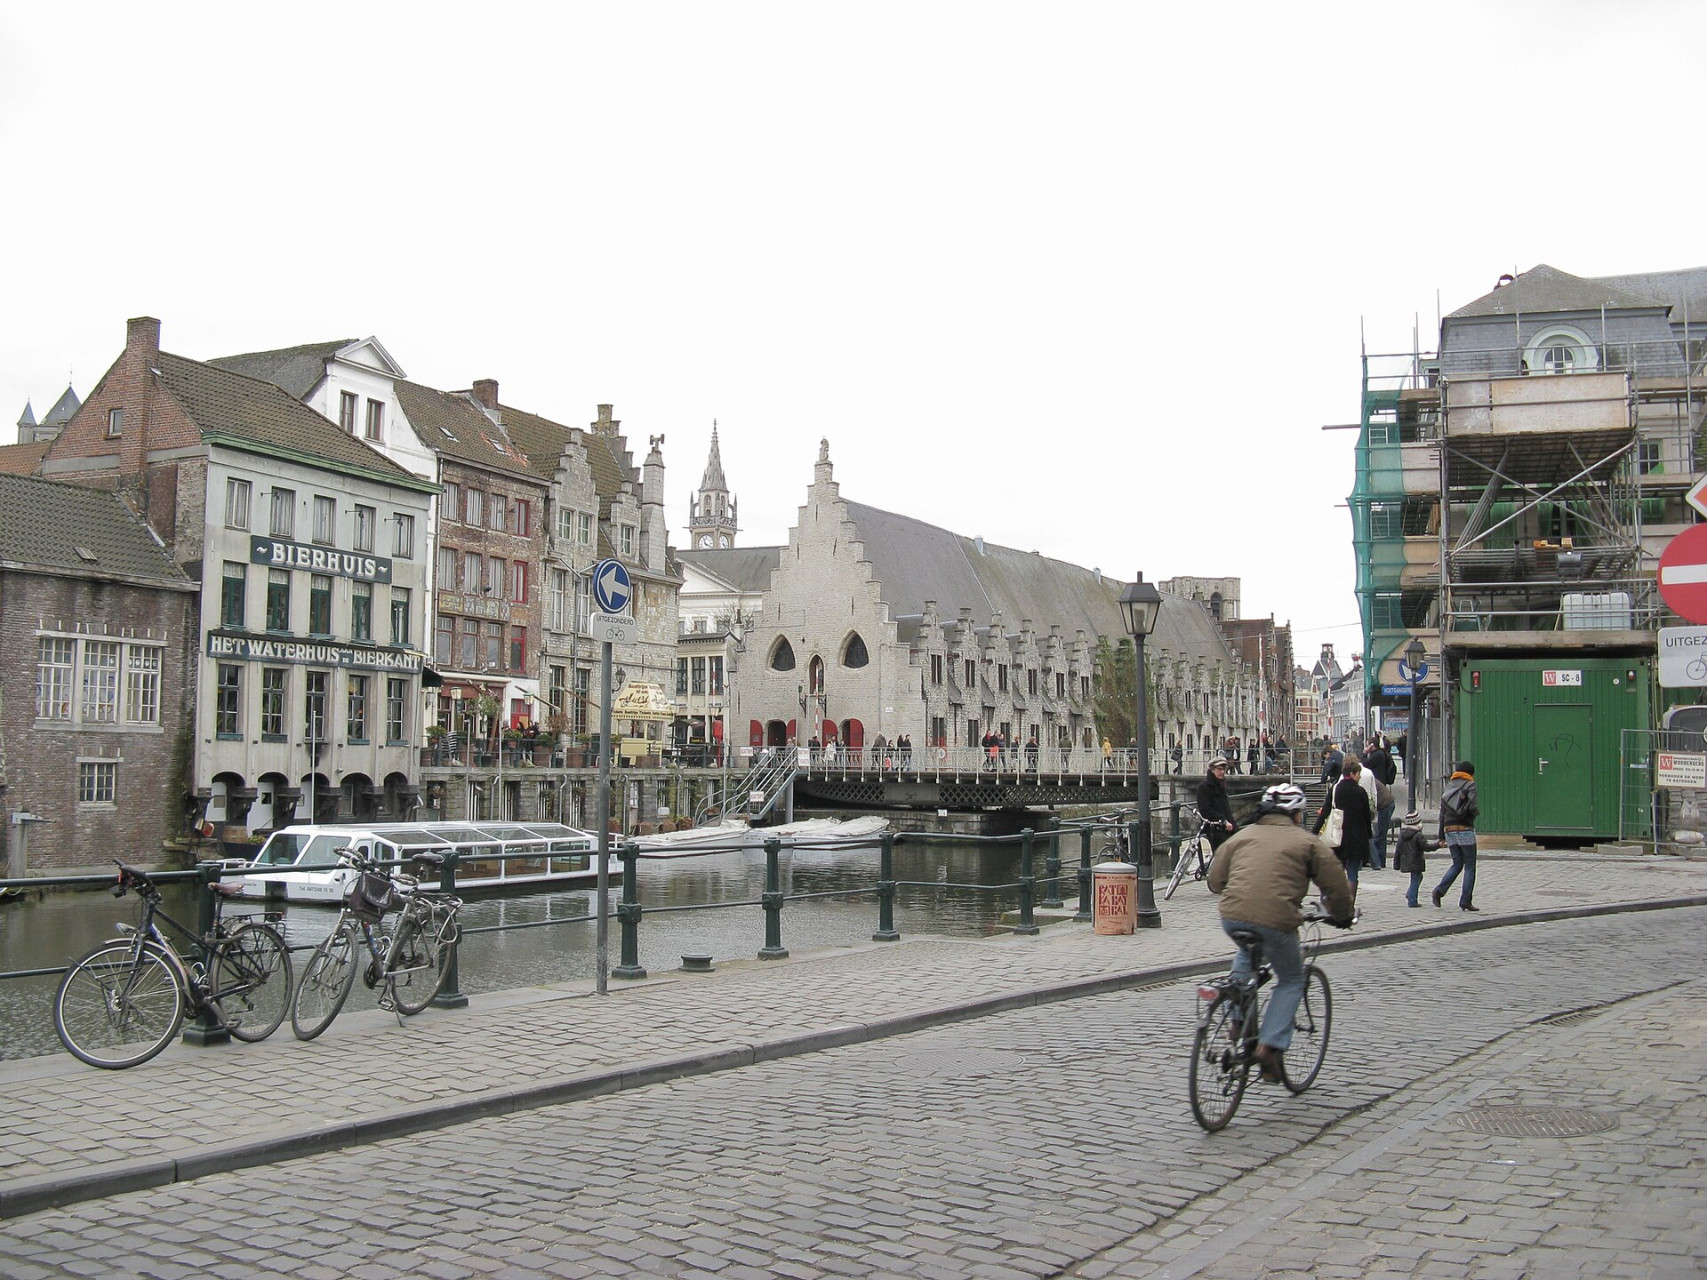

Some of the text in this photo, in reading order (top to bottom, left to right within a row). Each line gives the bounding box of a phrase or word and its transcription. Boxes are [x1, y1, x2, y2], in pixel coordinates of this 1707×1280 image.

[270, 542, 376, 578] BIERHUIS
[597, 616, 634, 625] UITGEZONDERD
[210, 635, 245, 656] HET
[248, 639, 340, 663] WATERHUIS
[353, 650, 421, 670] BIERKANT
[1561, 673, 1570, 682] SC
